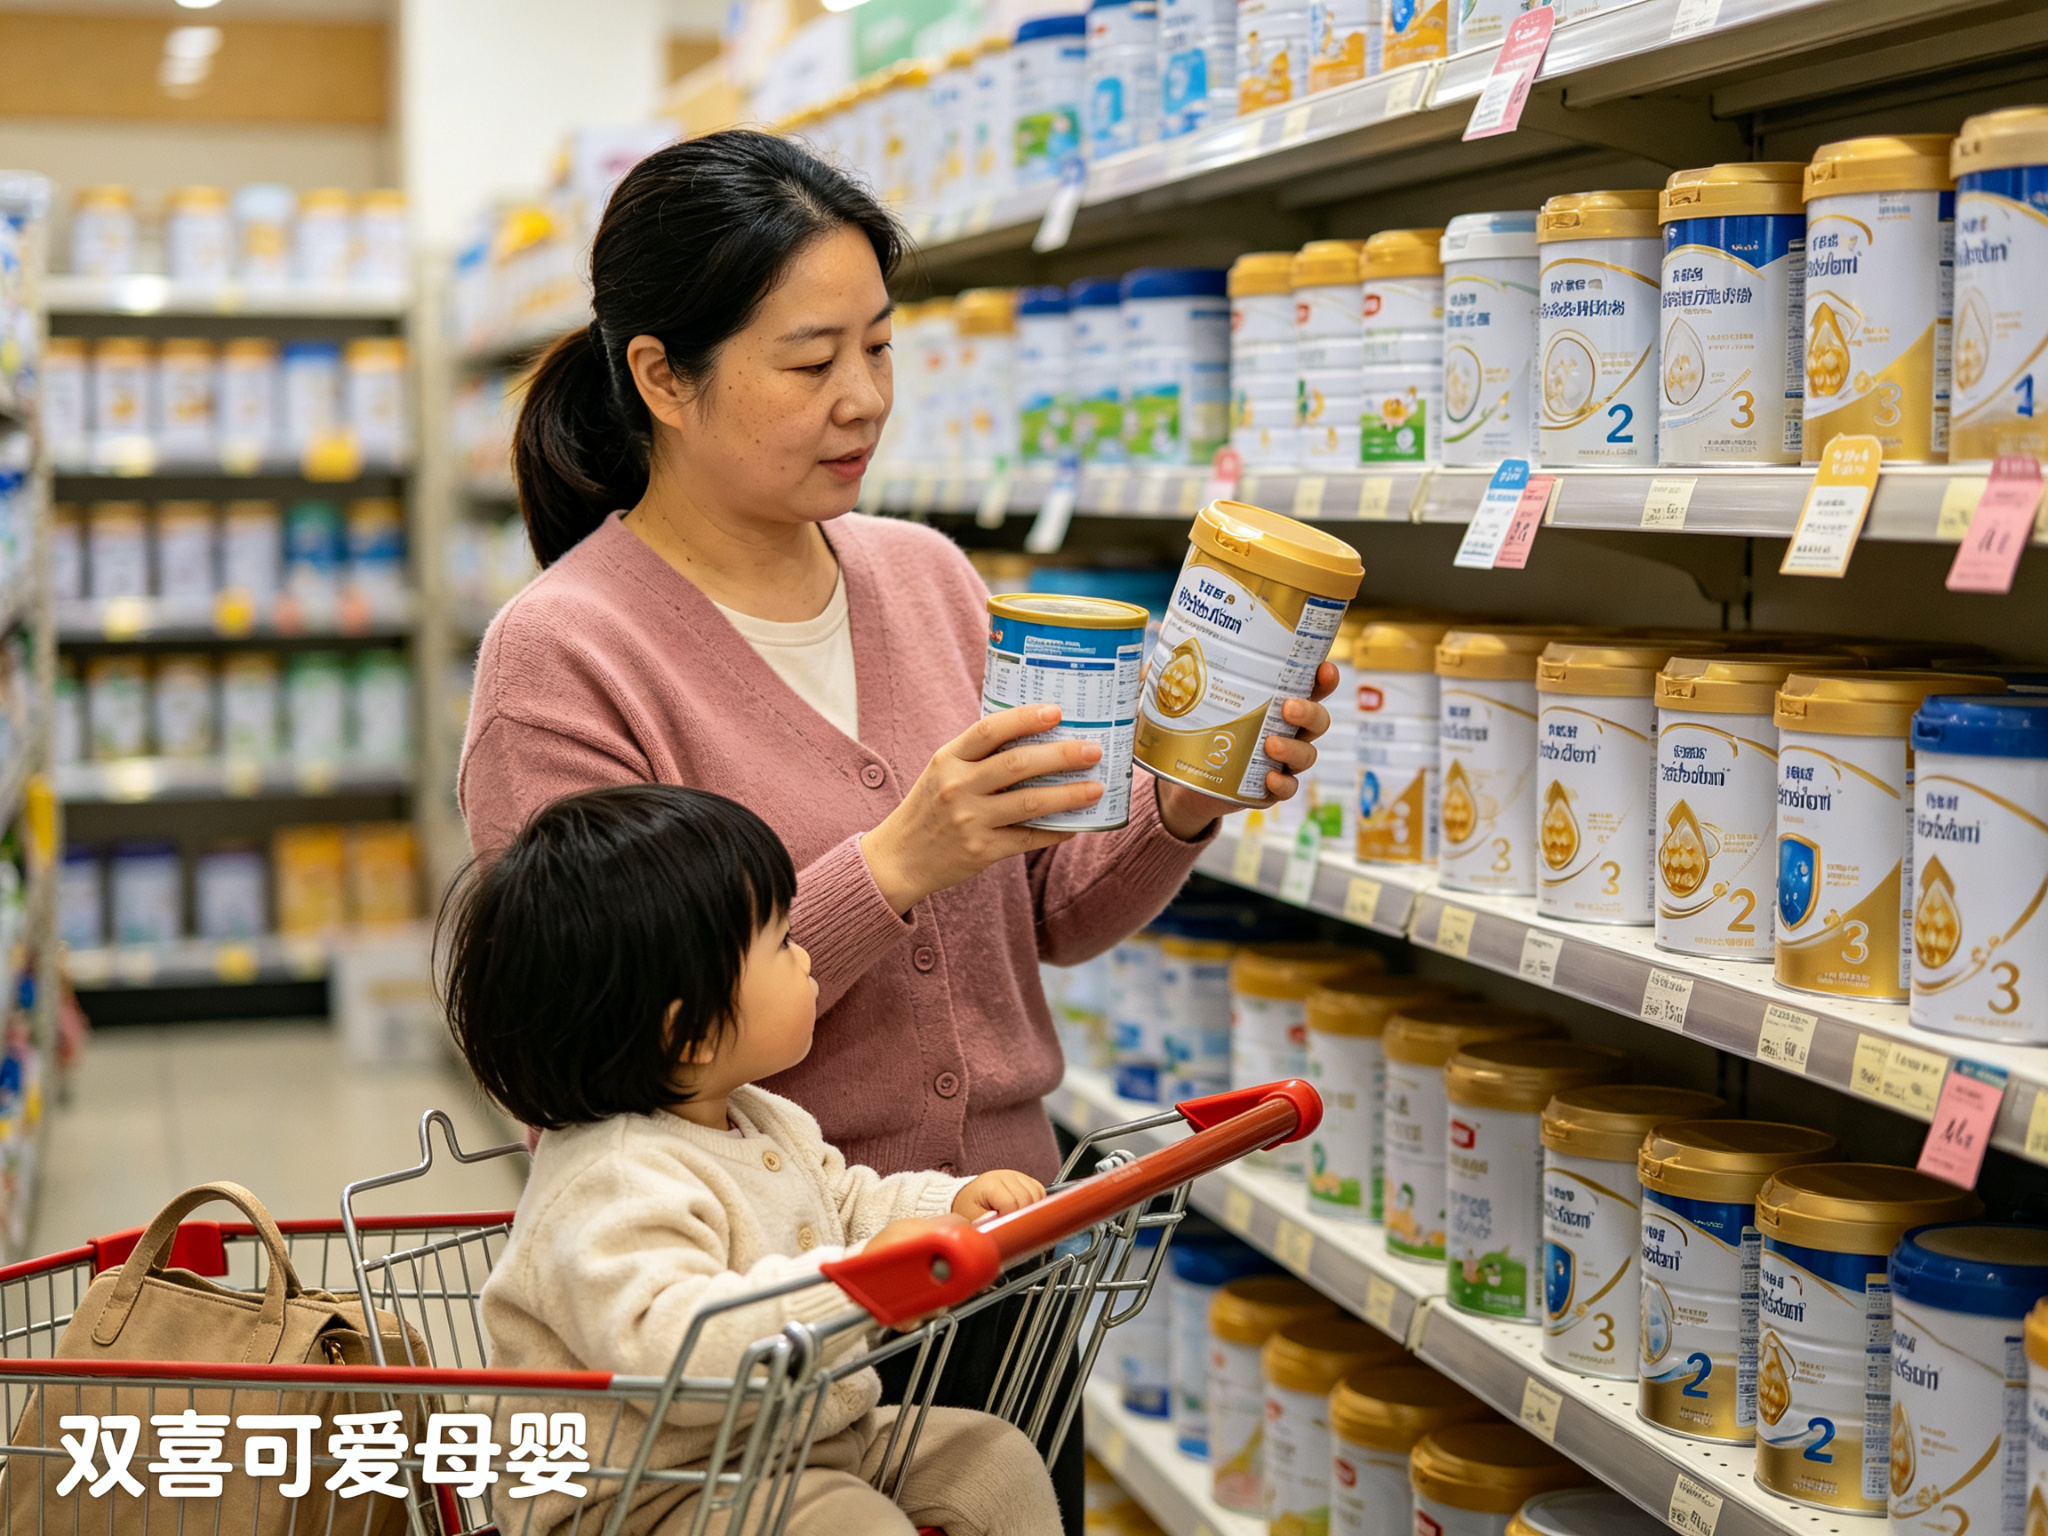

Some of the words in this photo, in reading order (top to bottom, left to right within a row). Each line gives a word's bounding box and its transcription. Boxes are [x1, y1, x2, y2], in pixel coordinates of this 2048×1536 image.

[1730, 390, 1755, 429] 3
[1873, 382, 1903, 426] 3
[2013, 373, 2034, 419] 1
[1606, 403, 1634, 444] 2
[1491, 838, 1512, 873] 3
[1599, 861, 1621, 896] 3
[1727, 887, 1756, 933] 2
[1841, 920, 1869, 964] 3
[1987, 961, 2020, 1014] 3
[1592, 1312, 1616, 1352] 3
[1682, 1352, 1713, 1399] 2
[1803, 1417, 1834, 1464] 2
